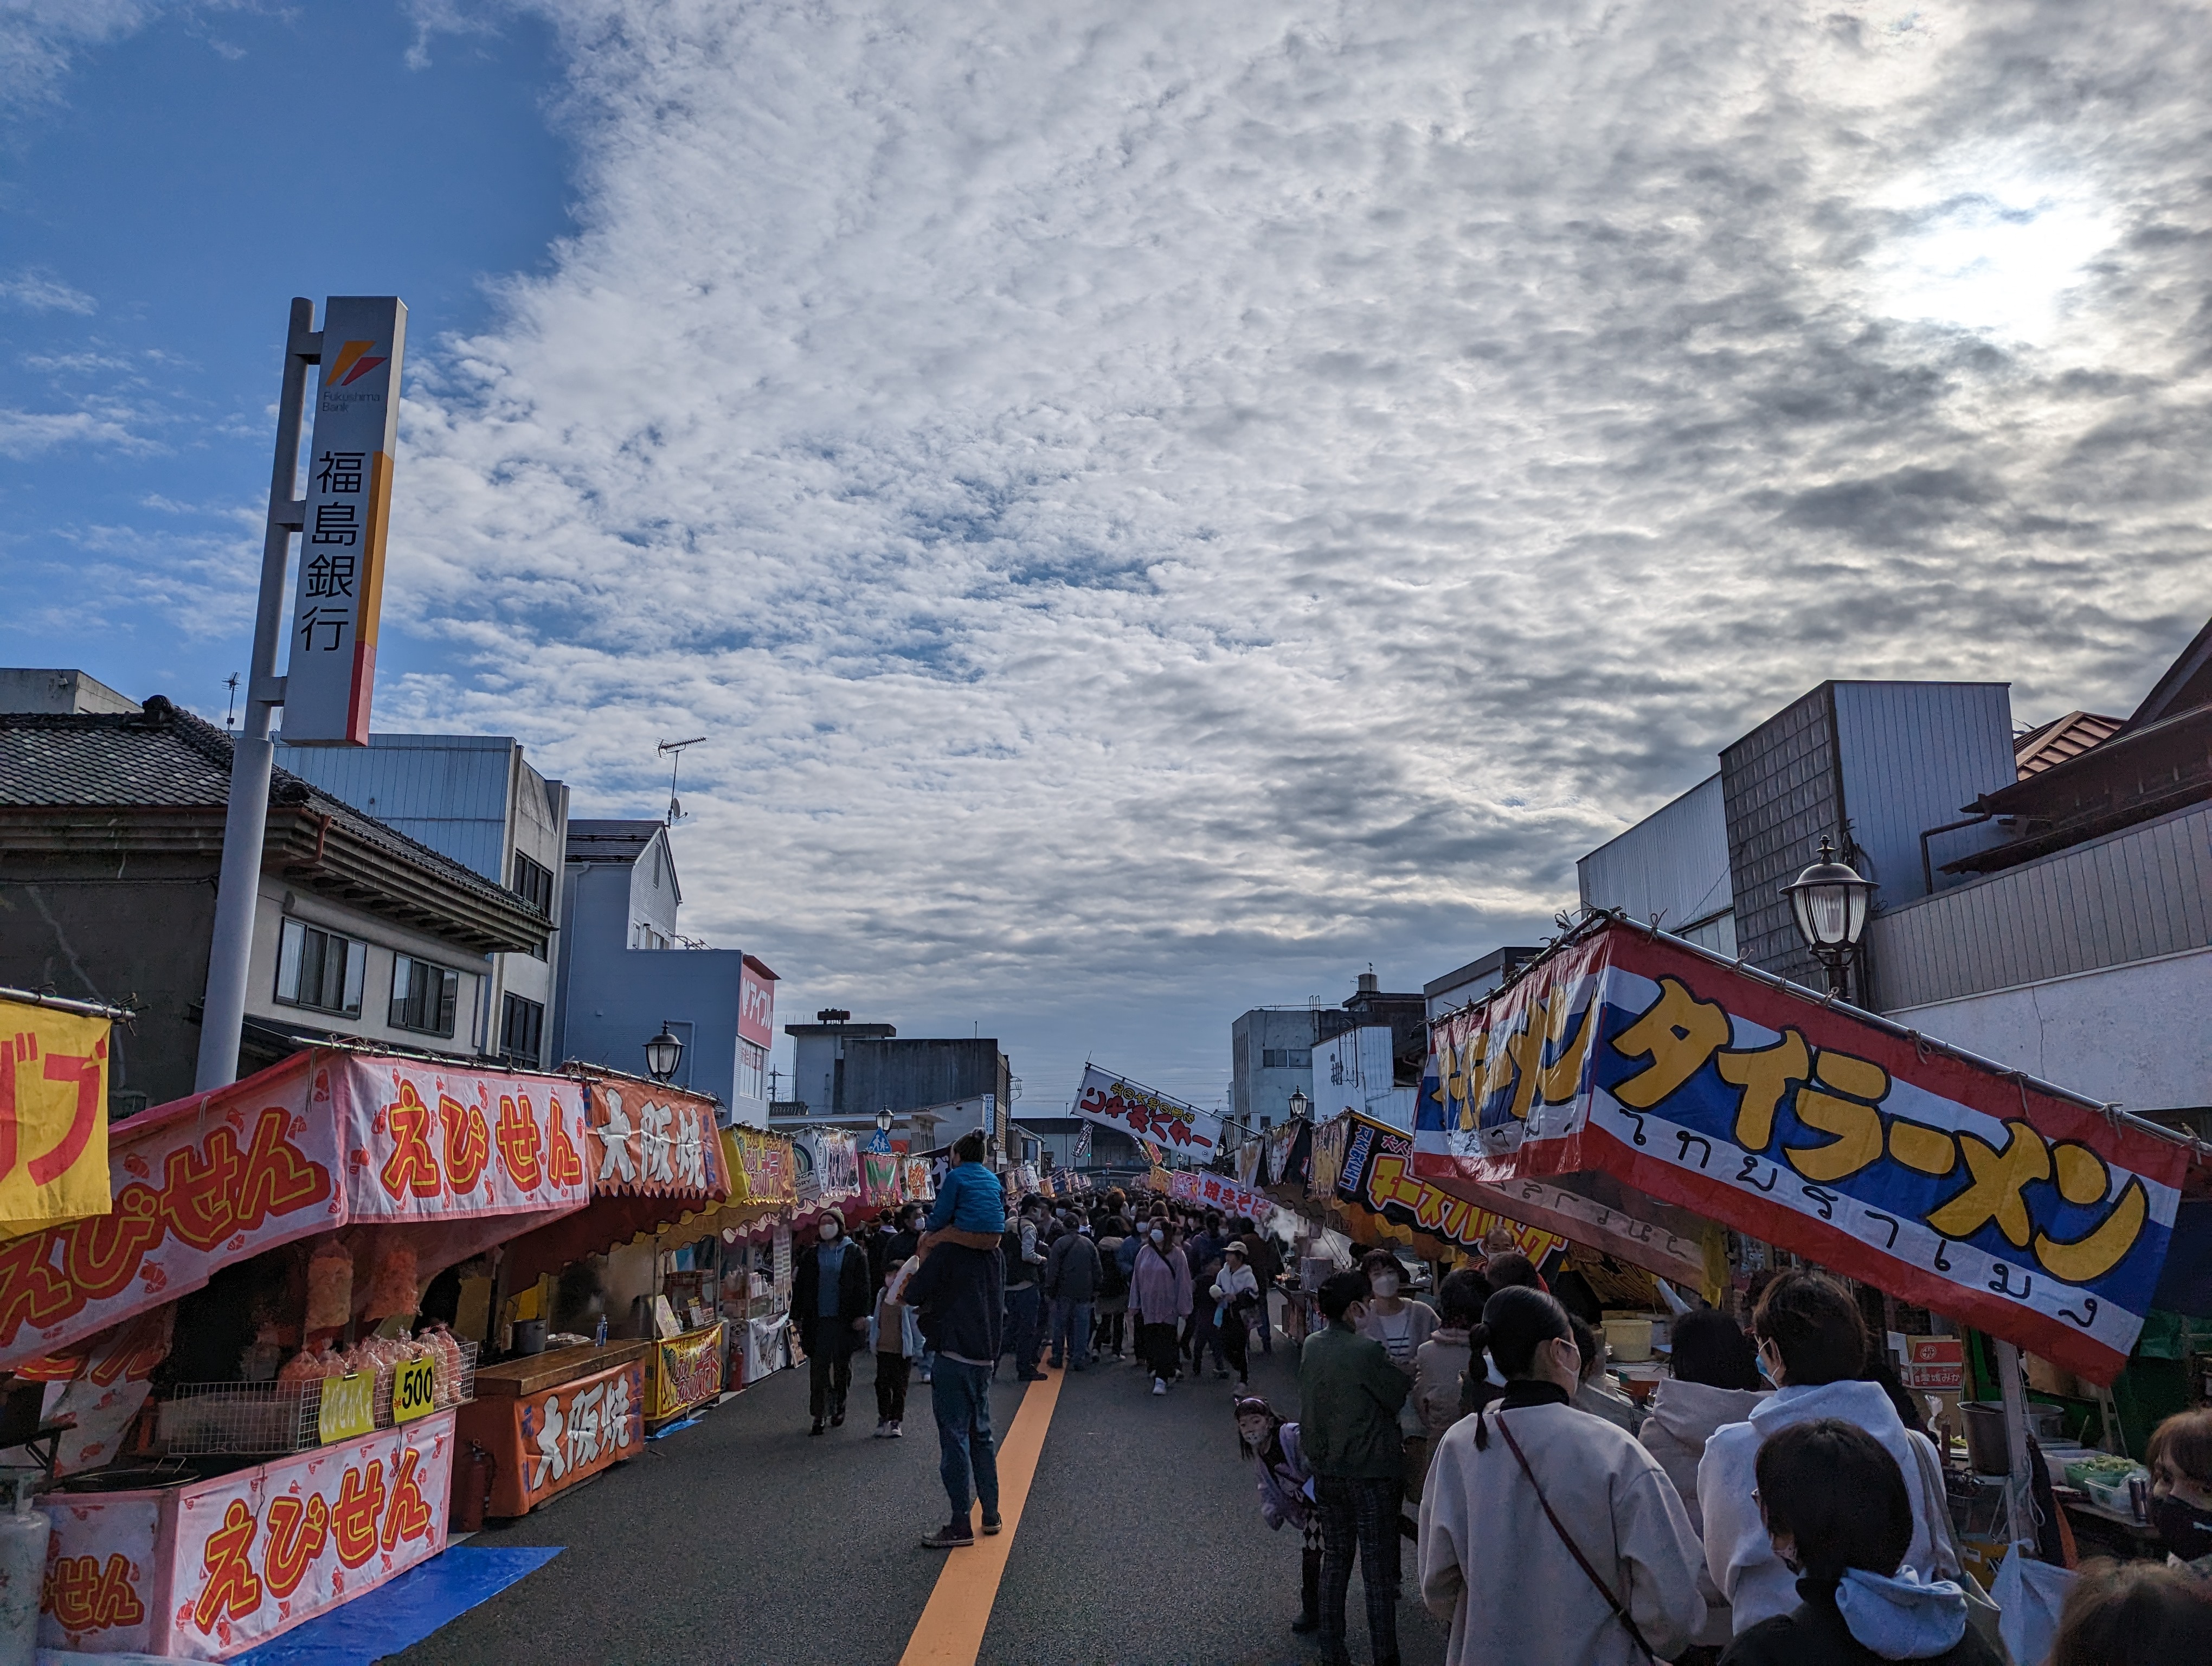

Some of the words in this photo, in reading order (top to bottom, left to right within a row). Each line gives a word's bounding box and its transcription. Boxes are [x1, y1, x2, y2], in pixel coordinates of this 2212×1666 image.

[322, 402, 349, 412] Bank
[324, 392, 380, 402] Fukushima
[300, 451, 365, 651] 福島銀行
[750, 982, 773, 1030] アイフル
[1081, 1087, 1213, 1148] じゃがバター
[1111, 1083, 1194, 1124] 北の大地の恵み
[1609, 975, 2150, 1285] タイラーメン
[381, 1078, 583, 1201] えびせん
[597, 1087, 705, 1189] 大阪焼
[1381, 1135, 1413, 1158] 大人
[1204, 1179, 1271, 1216] 焼きそば
[532, 1372, 630, 1494] 大阪焼
[195, 1448, 432, 1636] えびせん
